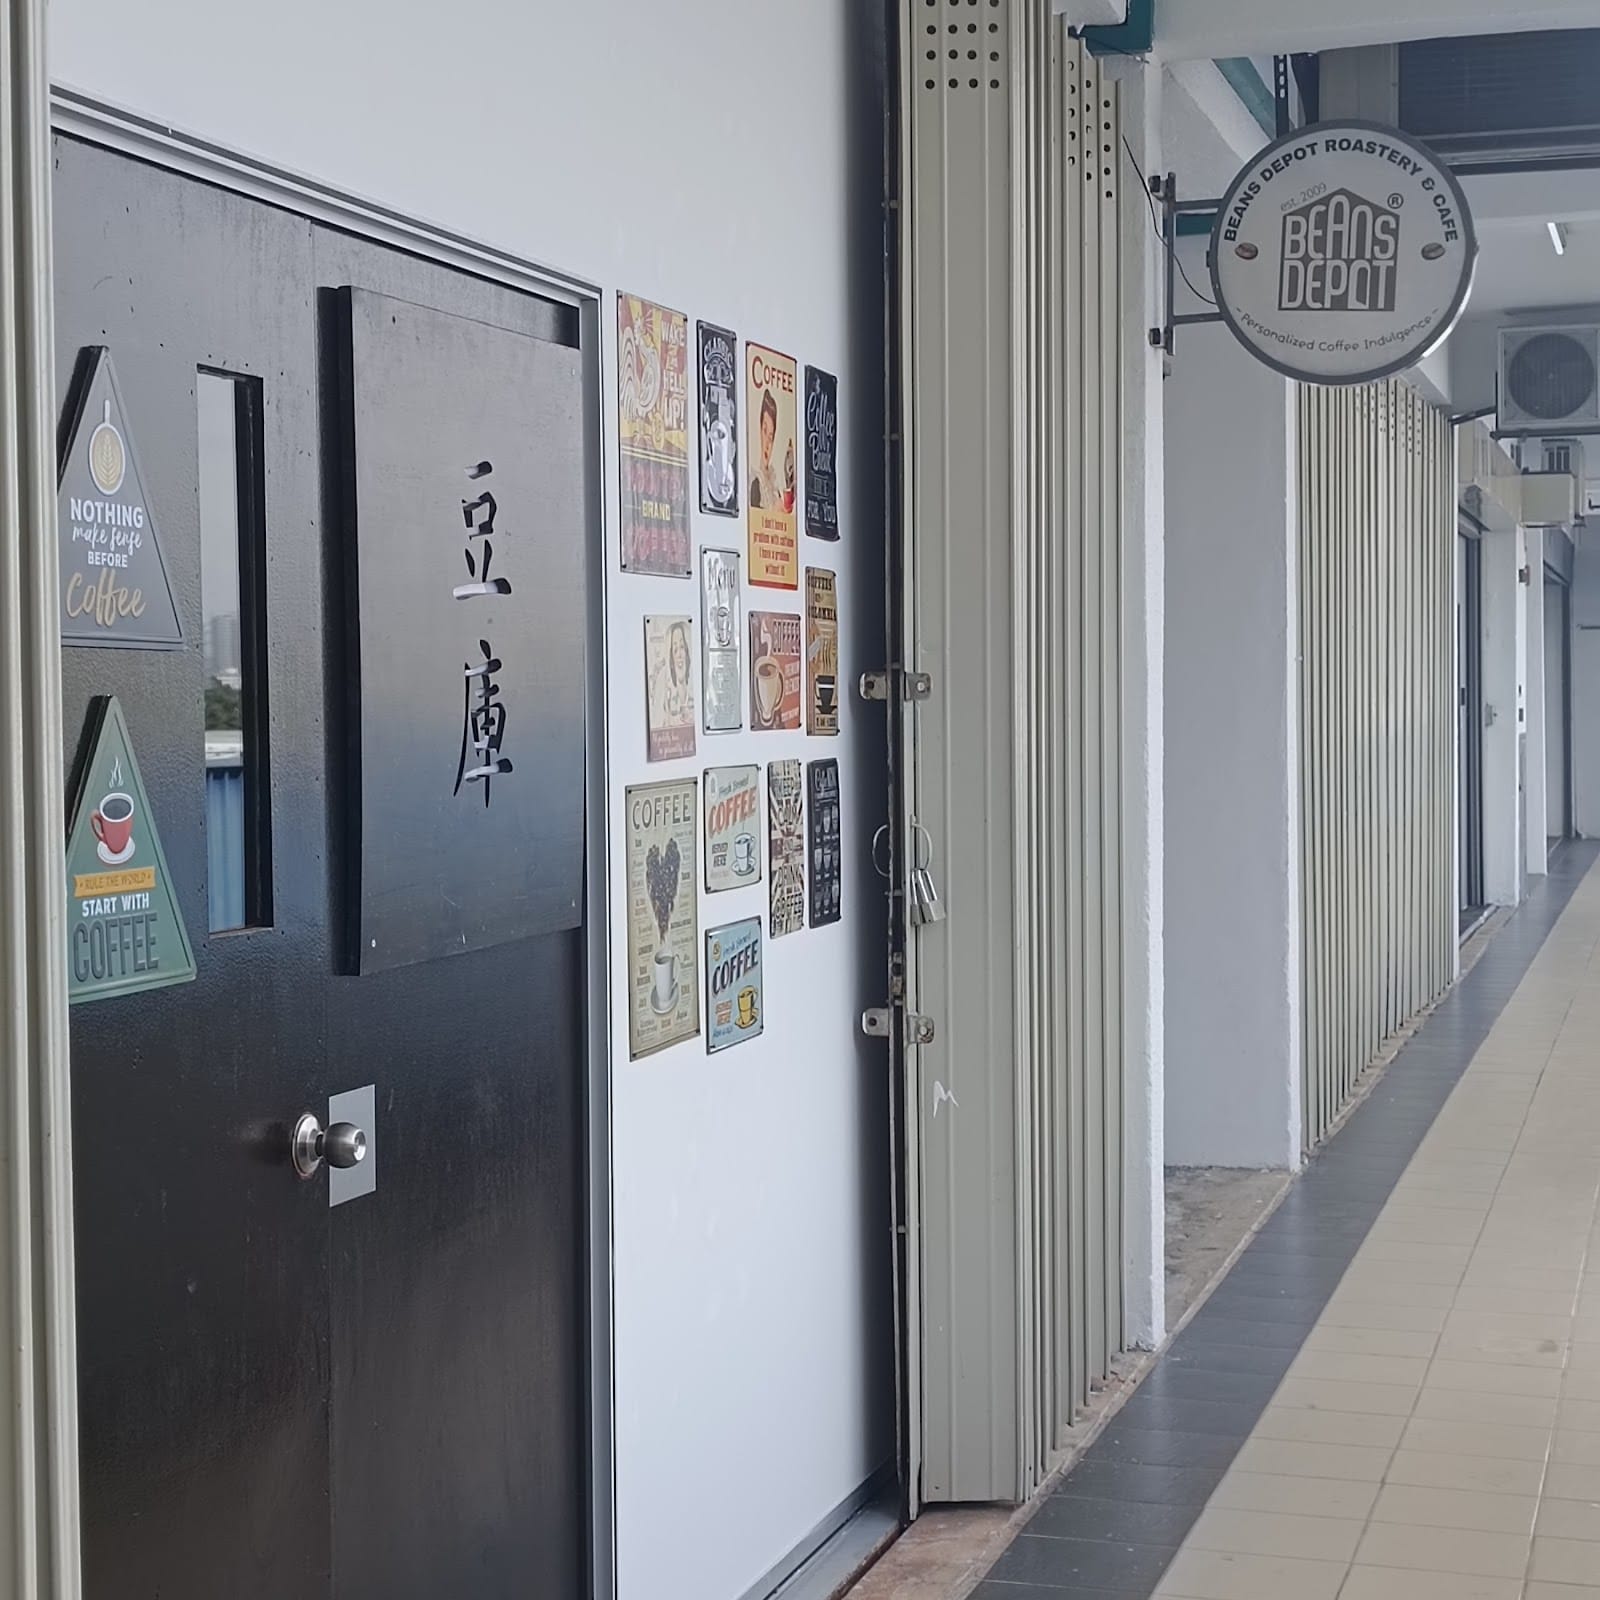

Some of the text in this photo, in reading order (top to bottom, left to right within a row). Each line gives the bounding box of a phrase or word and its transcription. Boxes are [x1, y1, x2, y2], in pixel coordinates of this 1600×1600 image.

[1224, 137, 1459, 243] BEANS DEPOT ROASTERY & CAFE
[1301, 182, 1328, 202] 2009
[1284, 194, 1397, 260] BEANS
[1280, 259, 1395, 309] DEPOT
[661, 321, 686, 347] WAKE
[1241, 312, 1432, 352] Personalized Coffee Indulgence
[663, 369, 685, 394] HELL
[752, 355, 793, 393] COFFEE
[664, 397, 685, 432] UP!
[70, 497, 143, 529] NOTHING
[642, 500, 671, 521] BRAND
[823, 500, 836, 523] YOU
[72, 525, 108, 550] make
[87, 551, 128, 568] BEFORE
[708, 556, 736, 592] Menu
[66, 568, 146, 627] Coffee
[773, 620, 800, 654] COFFEE
[632, 793, 691, 831] COFFEE
[708, 786, 757, 839] COFFEE
[85, 872, 146, 890] RULE THE WORLD
[81, 892, 150, 918] START WITH
[73, 912, 159, 983] COFFEE
[712, 939, 759, 996] COFFEE
